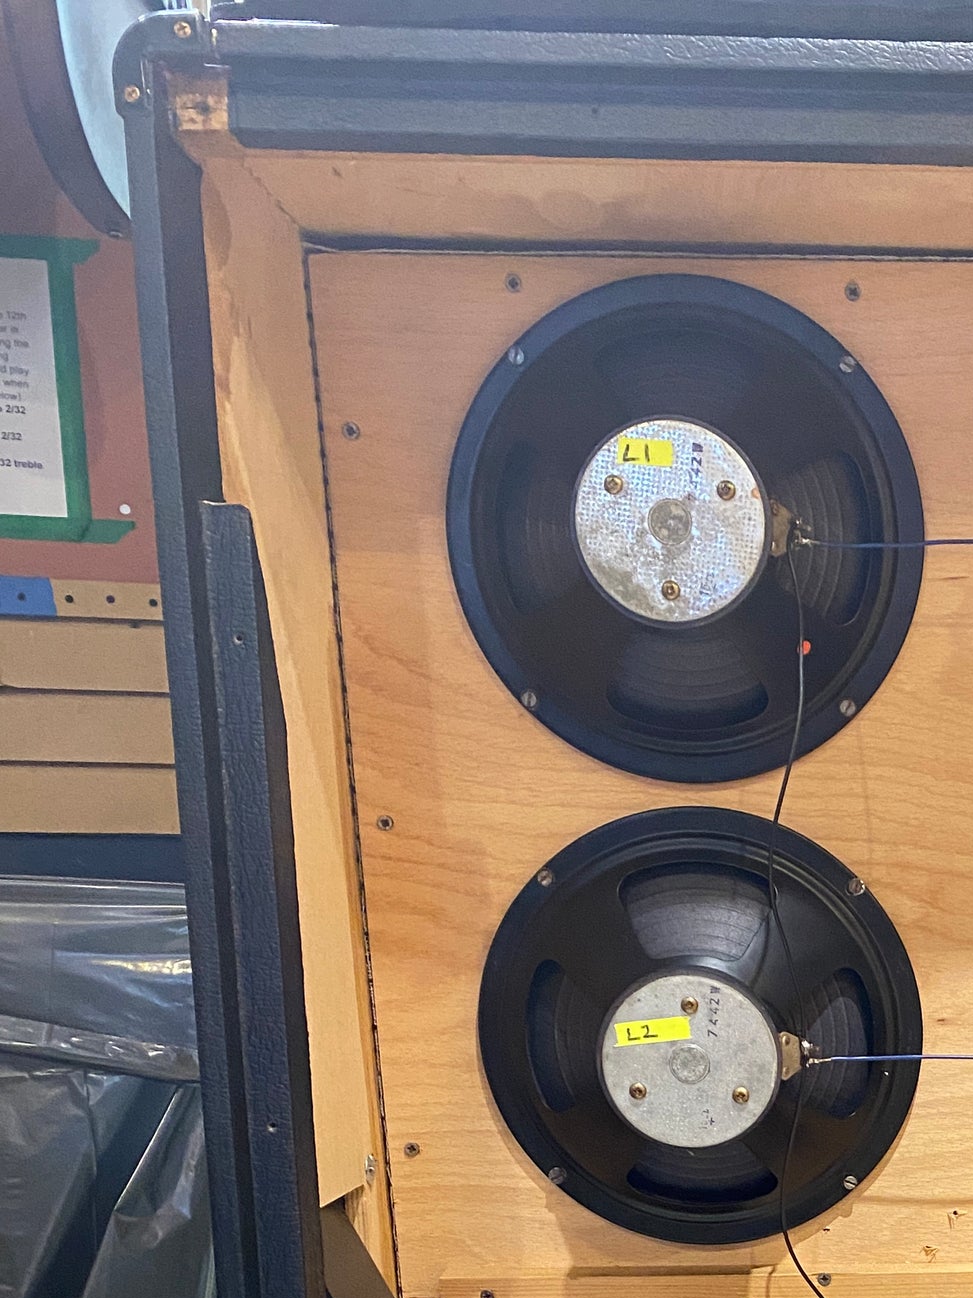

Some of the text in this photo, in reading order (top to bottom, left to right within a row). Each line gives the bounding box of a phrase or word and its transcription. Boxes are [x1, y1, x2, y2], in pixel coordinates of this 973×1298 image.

[14, 339, 29, 348] the
[9, 366, 29, 377] play
[3, 380, 29, 389] when
[5, 404, 26, 415] 2/32
[1, 431, 22, 441] 2/32
[622, 444, 650, 462] L1
[14, 460, 43, 470] treble
[626, 1025, 658, 1041] L2
